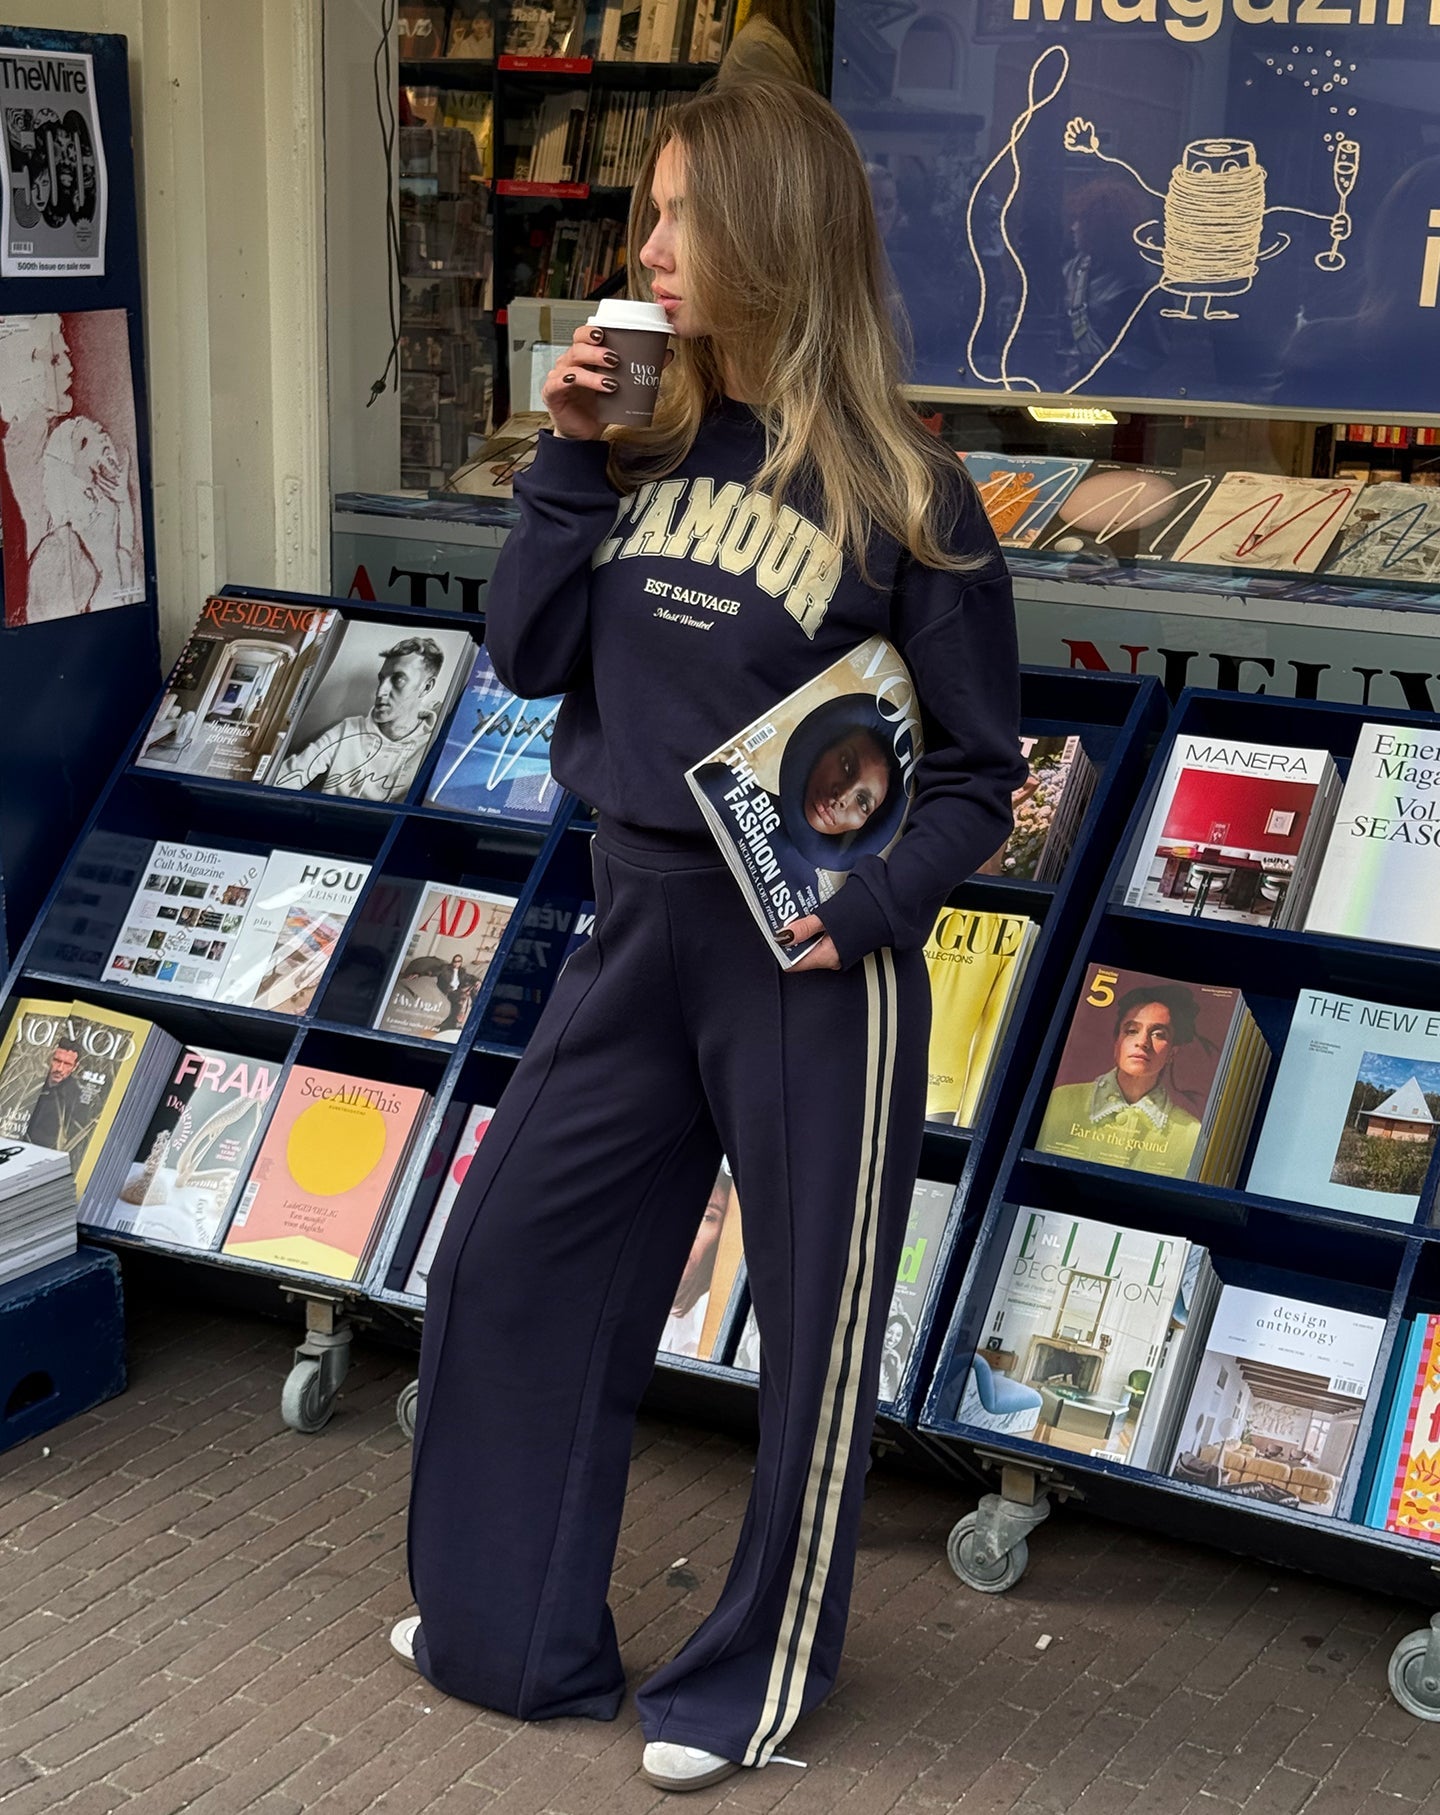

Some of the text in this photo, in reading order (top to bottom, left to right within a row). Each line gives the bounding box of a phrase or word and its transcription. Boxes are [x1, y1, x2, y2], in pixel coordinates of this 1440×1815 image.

[39, 262, 56, 271] issue
[57, 263, 65, 271] on
[630, 361, 656, 375] two
[643, 578, 741, 616] EST SAUVAGE
[205, 599, 333, 634] RESIDENCE
[653, 607, 715, 631] Most Wanted
[205, 733, 237, 745] glorie
[208, 720, 252, 737] Hollands
[1186, 744, 1308, 774] MANERA
[725, 747, 780, 835] THE BIG
[1394, 796, 1440, 823] Vol.
[723, 786, 781, 883] FASHION
[153, 858, 225, 879] Cult Magazine
[158, 845, 222, 865] Not So Diffi-
[738, 838, 761, 884] MICHAELA
[299, 865, 364, 892] HOU
[254, 917, 272, 928] play
[419, 895, 481, 939] AD
[1086, 973, 1118, 1008] 5
[1308, 995, 1353, 1022] THE
[1359, 1007, 1418, 1033] NEW
[301, 1076, 402, 1114] See All This
[1070, 1122, 1089, 1138] Ear
[1093, 1129, 1105, 1141] to
[1107, 1134, 1126, 1147] the
[1125, 1139, 1169, 1154] ground
[1018, 1213, 1174, 1288] ELLE
[1041, 1233, 1060, 1248] NL
[1013, 1258, 1163, 1307] DECORAION
[1273, 1306, 1327, 1328] design
[1256, 1318, 1338, 1346] anthology
